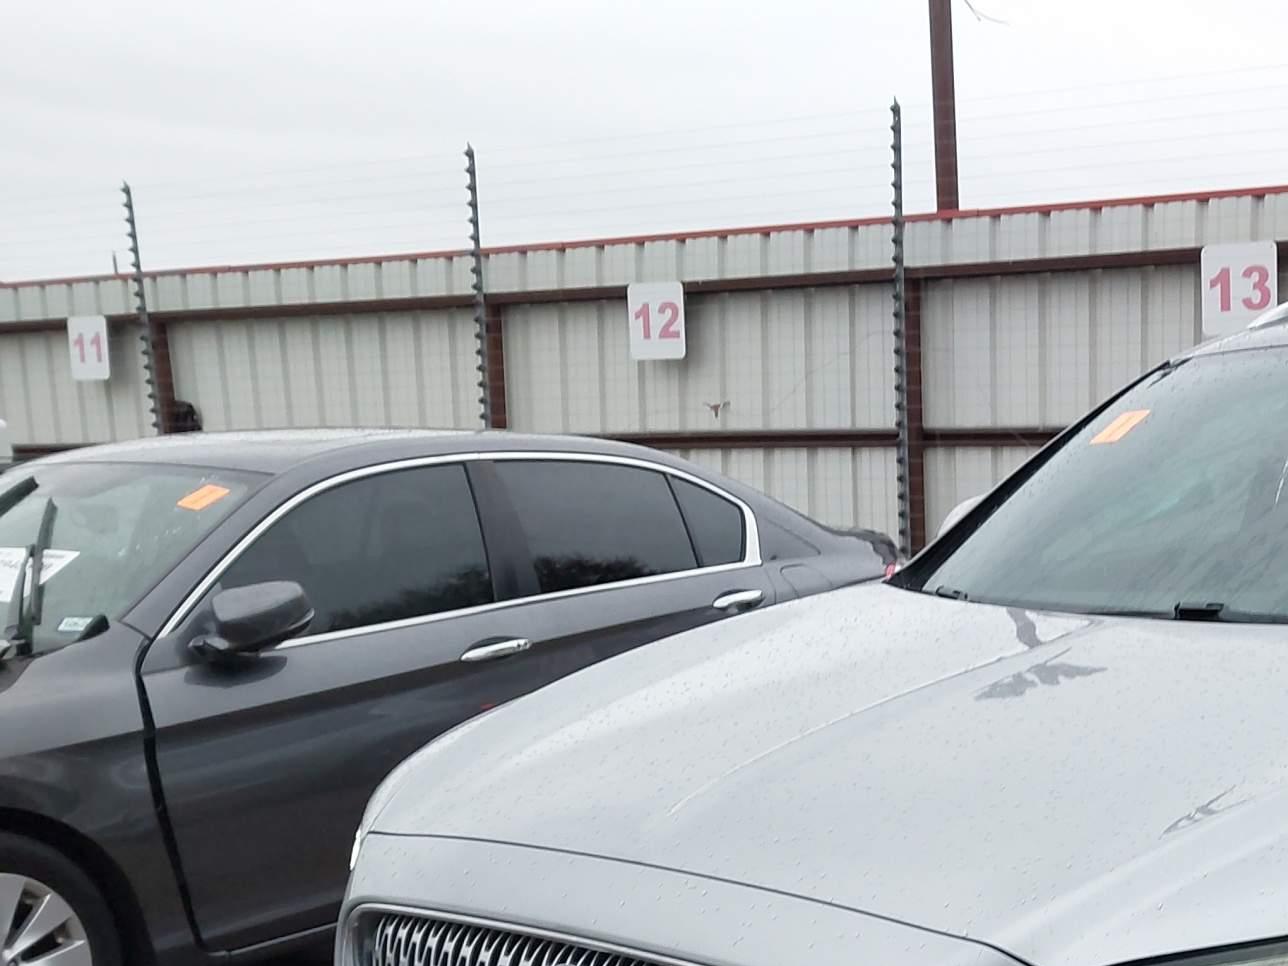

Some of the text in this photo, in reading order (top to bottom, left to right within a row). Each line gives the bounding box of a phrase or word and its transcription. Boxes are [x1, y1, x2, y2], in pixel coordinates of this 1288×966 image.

[1209, 265, 1271, 312] 13
[634, 301, 680, 340] 12
[73, 332, 102, 363] 11
